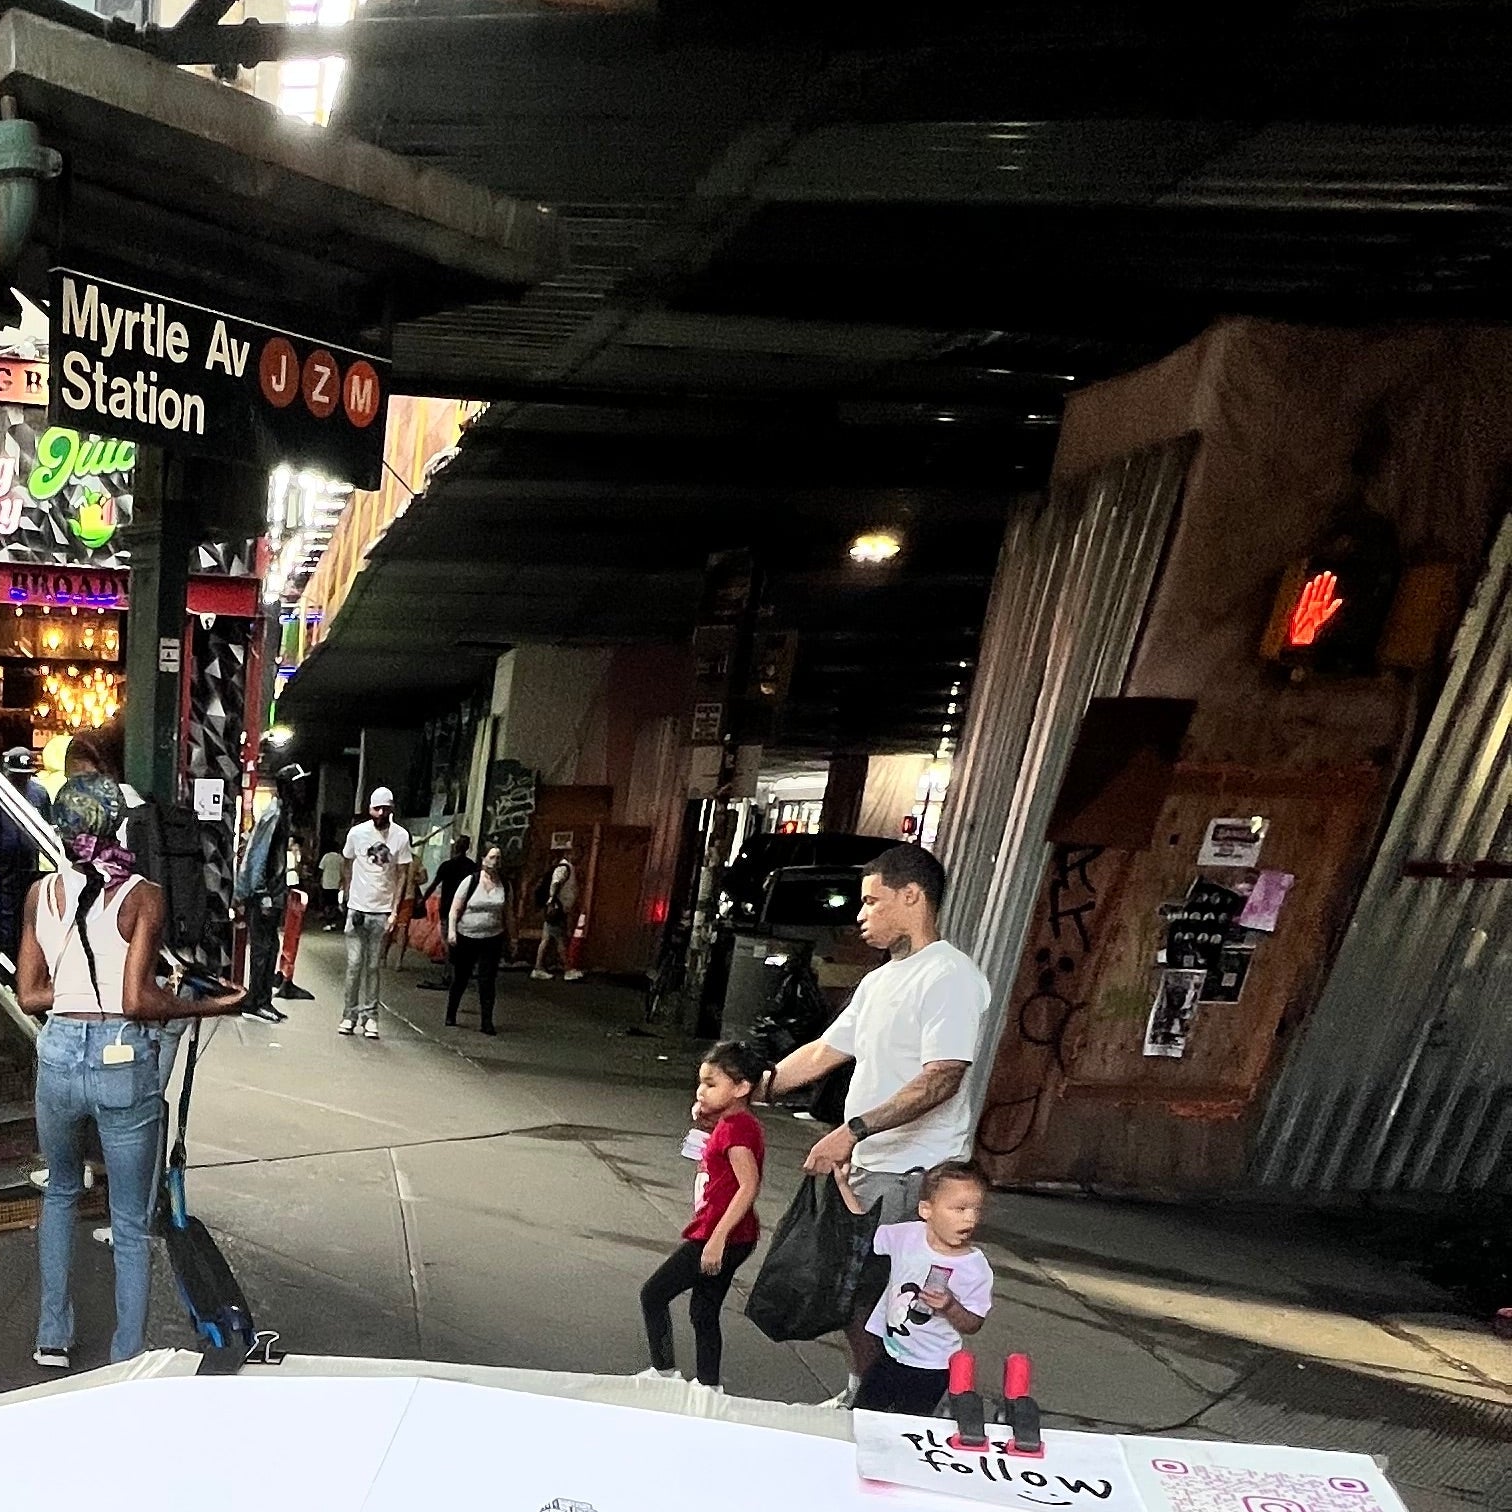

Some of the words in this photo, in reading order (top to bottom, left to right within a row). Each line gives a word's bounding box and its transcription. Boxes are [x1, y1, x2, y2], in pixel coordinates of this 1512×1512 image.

[62, 276, 189, 363] Myrtle
[205, 319, 251, 377] Av
[271, 355, 286, 392] J
[311, 364, 330, 404] Z
[349, 375, 373, 414] M
[61, 350, 205, 435] Station
[918, 1449, 1113, 1500] follow
